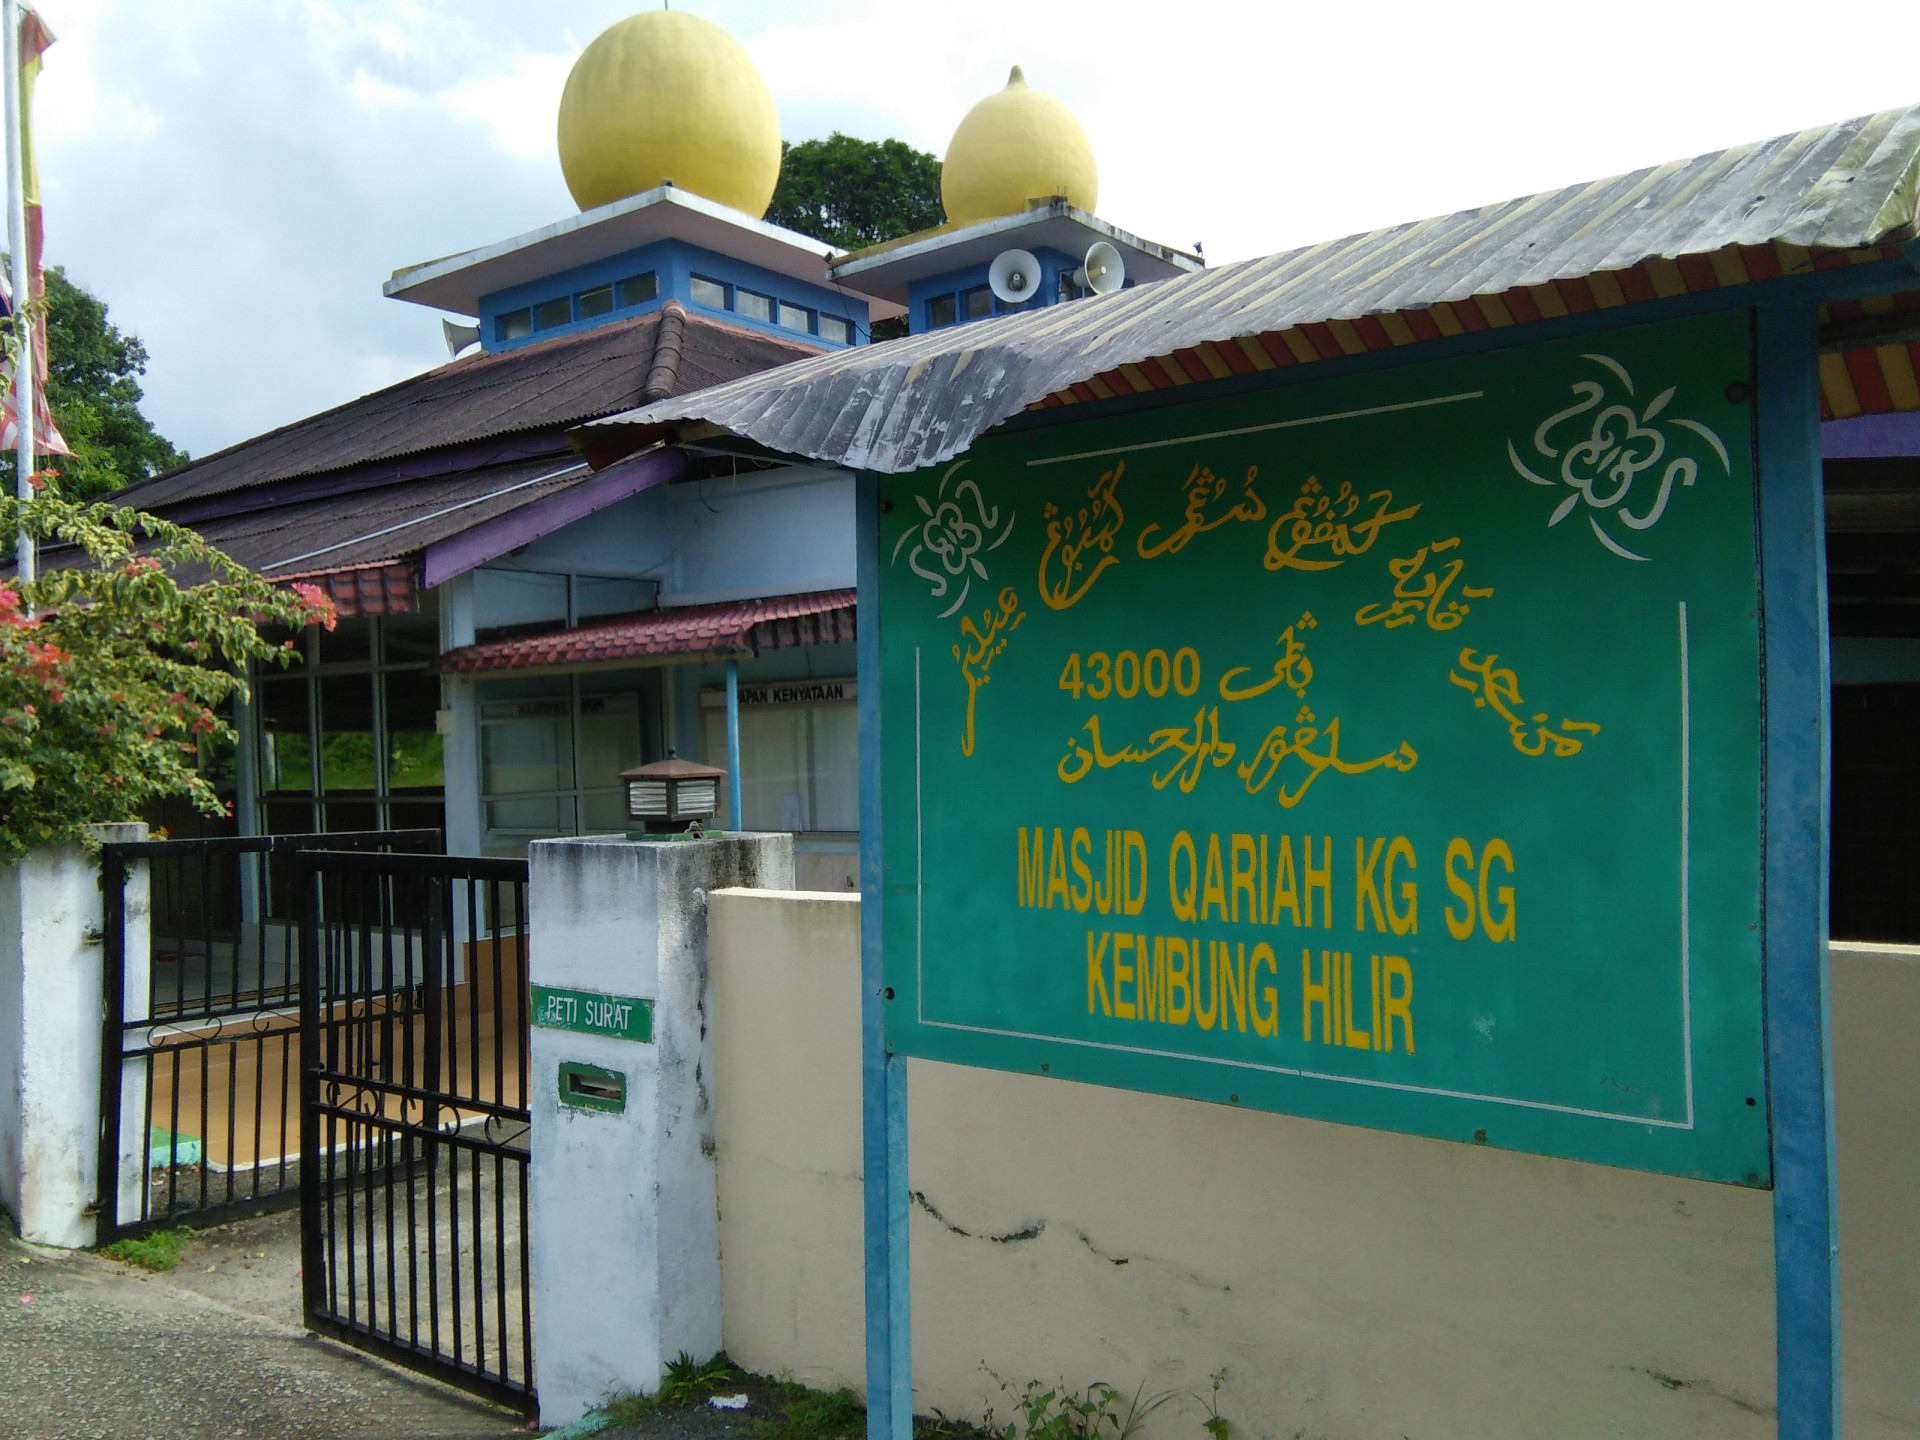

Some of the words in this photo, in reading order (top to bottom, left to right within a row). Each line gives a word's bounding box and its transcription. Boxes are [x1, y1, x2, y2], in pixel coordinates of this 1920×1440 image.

[737, 688, 769, 704] APAN
[772, 684, 844, 703] KENYATAAN
[1058, 646, 1201, 701] 43000
[1018, 826, 1148, 916] MASJID
[1169, 830, 1333, 928] QARIAH
[1356, 836, 1418, 936] KG
[1445, 837, 1516, 943] SG
[547, 995, 577, 1023] PETI
[585, 1000, 633, 1030] SURAT
[1087, 931, 1279, 1037] KEMBUNG
[1303, 949, 1415, 1056] HILIR
